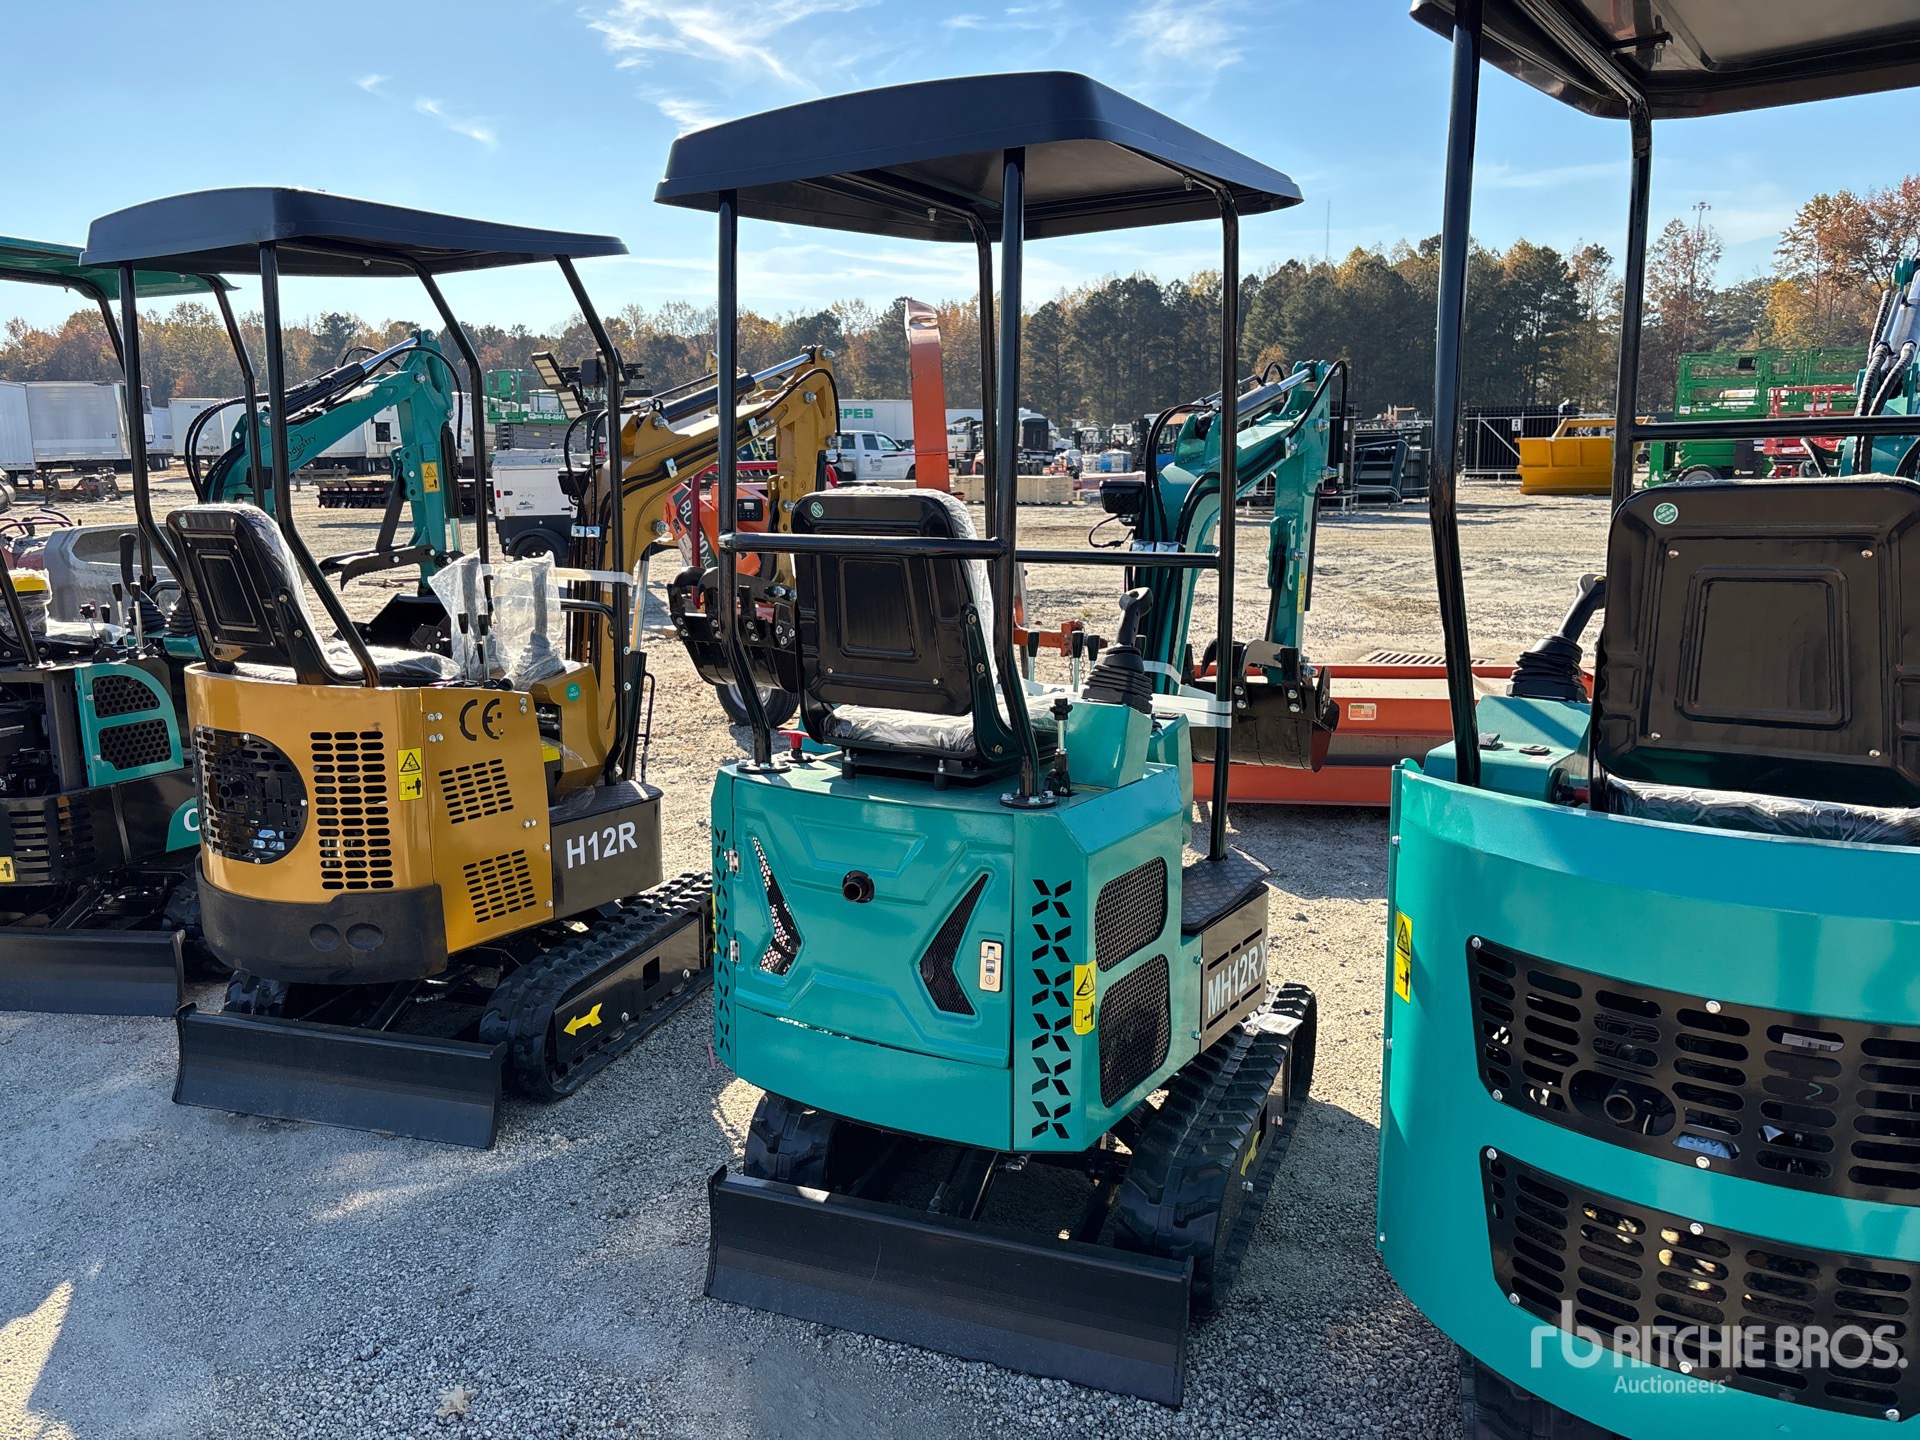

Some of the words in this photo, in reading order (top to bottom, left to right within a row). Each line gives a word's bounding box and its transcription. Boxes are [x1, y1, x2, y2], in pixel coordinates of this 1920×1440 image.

[840, 408, 873, 419] PES
[288, 434, 317, 457] ndustry
[566, 821, 638, 869] H12R
[1207, 936, 1268, 1019] MH12RX
